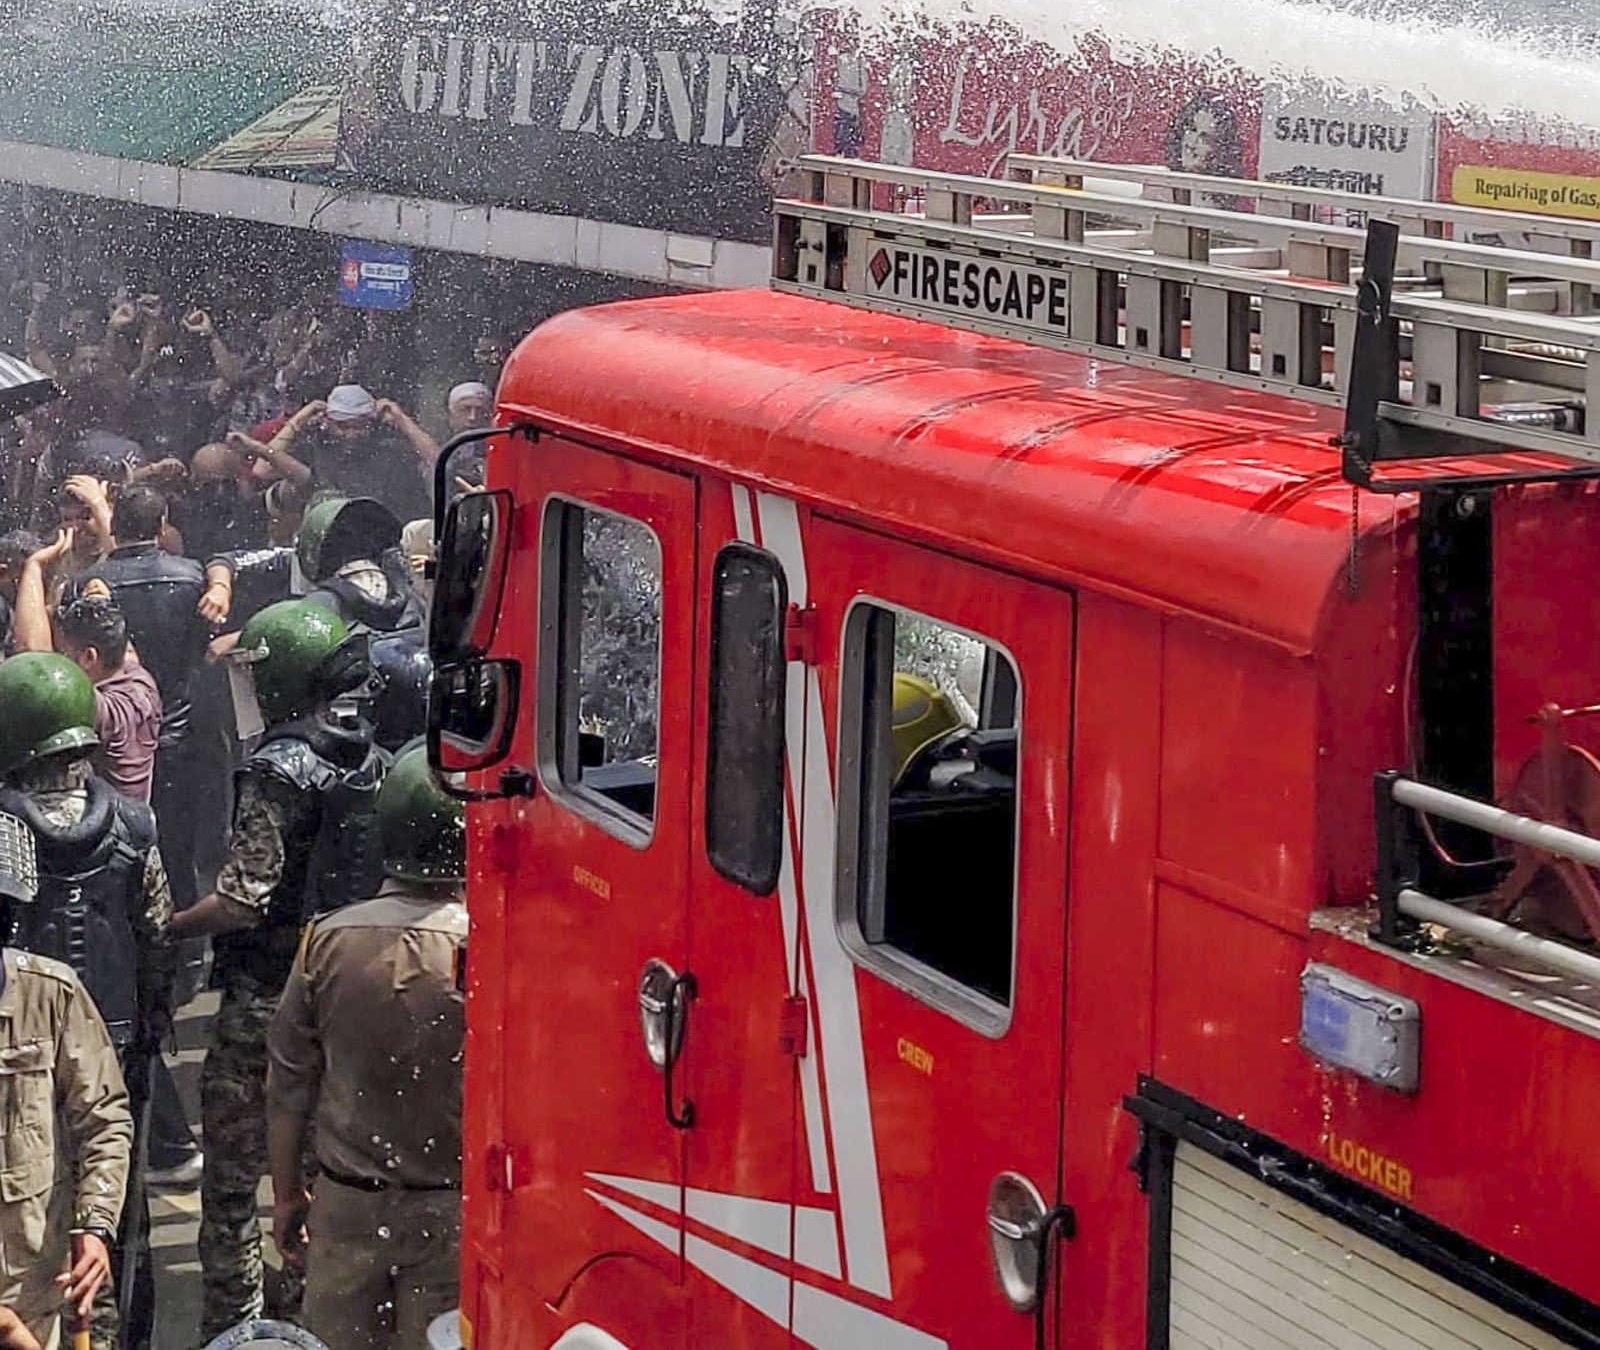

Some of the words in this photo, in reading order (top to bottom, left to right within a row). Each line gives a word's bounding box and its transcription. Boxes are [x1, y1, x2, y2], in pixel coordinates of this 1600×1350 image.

[400, 36, 547, 127] GIFT
[560, 42, 747, 148] ZONE
[1274, 116, 1410, 153] SATGURU
[1475, 178, 1549, 206] Repairing
[1551, 186, 1569, 204] of
[893, 249, 1068, 327] FIRESCAPE
[573, 864, 611, 902] OFFICER
[897, 1037, 935, 1076] CREW
[1328, 1131, 1412, 1201] LOCKER
